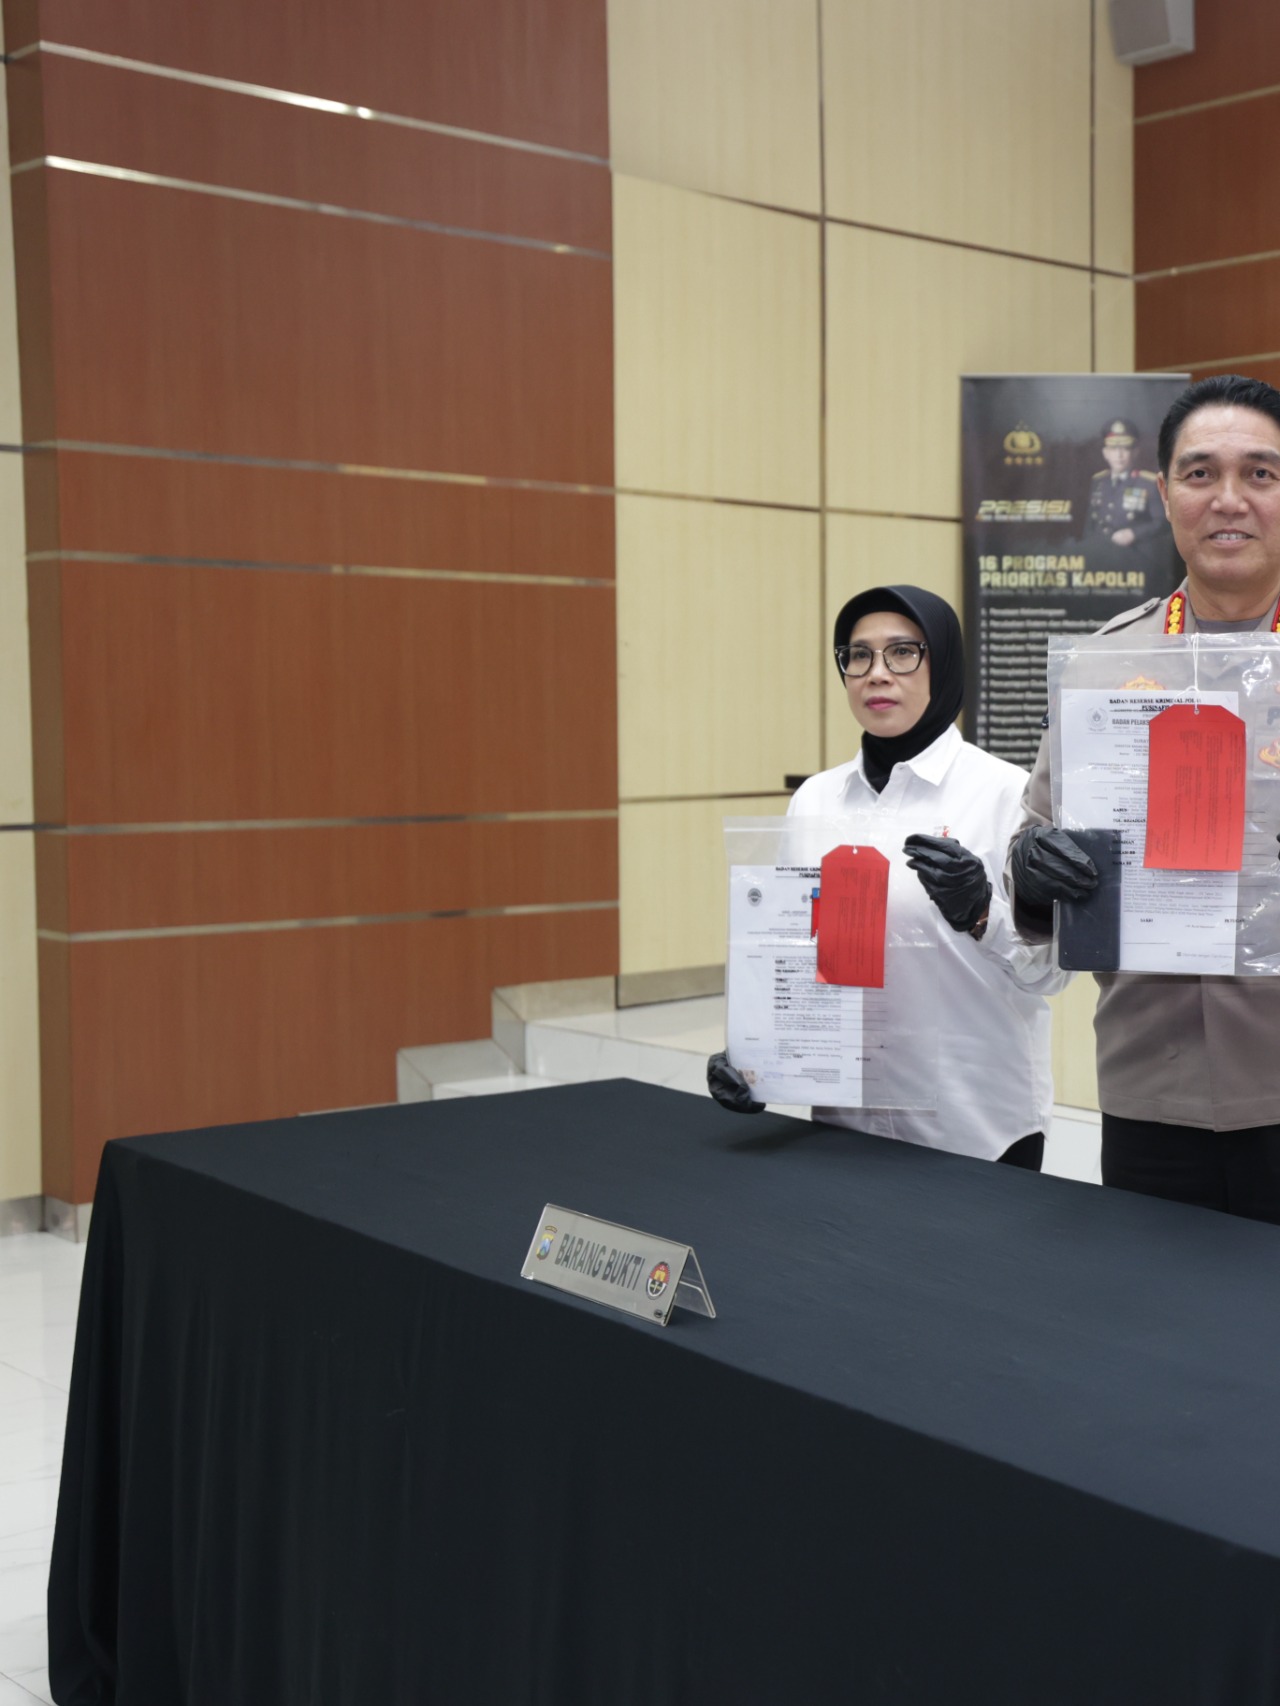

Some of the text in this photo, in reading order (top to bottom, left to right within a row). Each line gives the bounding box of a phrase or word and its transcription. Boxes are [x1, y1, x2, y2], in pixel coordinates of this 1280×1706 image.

[978, 555, 1086, 571] 16 PROGRAM
[979, 571, 1145, 588] PRIORITAS KAPOLRI
[1131, 718, 1150, 726] PELAKS
[554, 1233, 646, 1291] BARANG BUKTI
